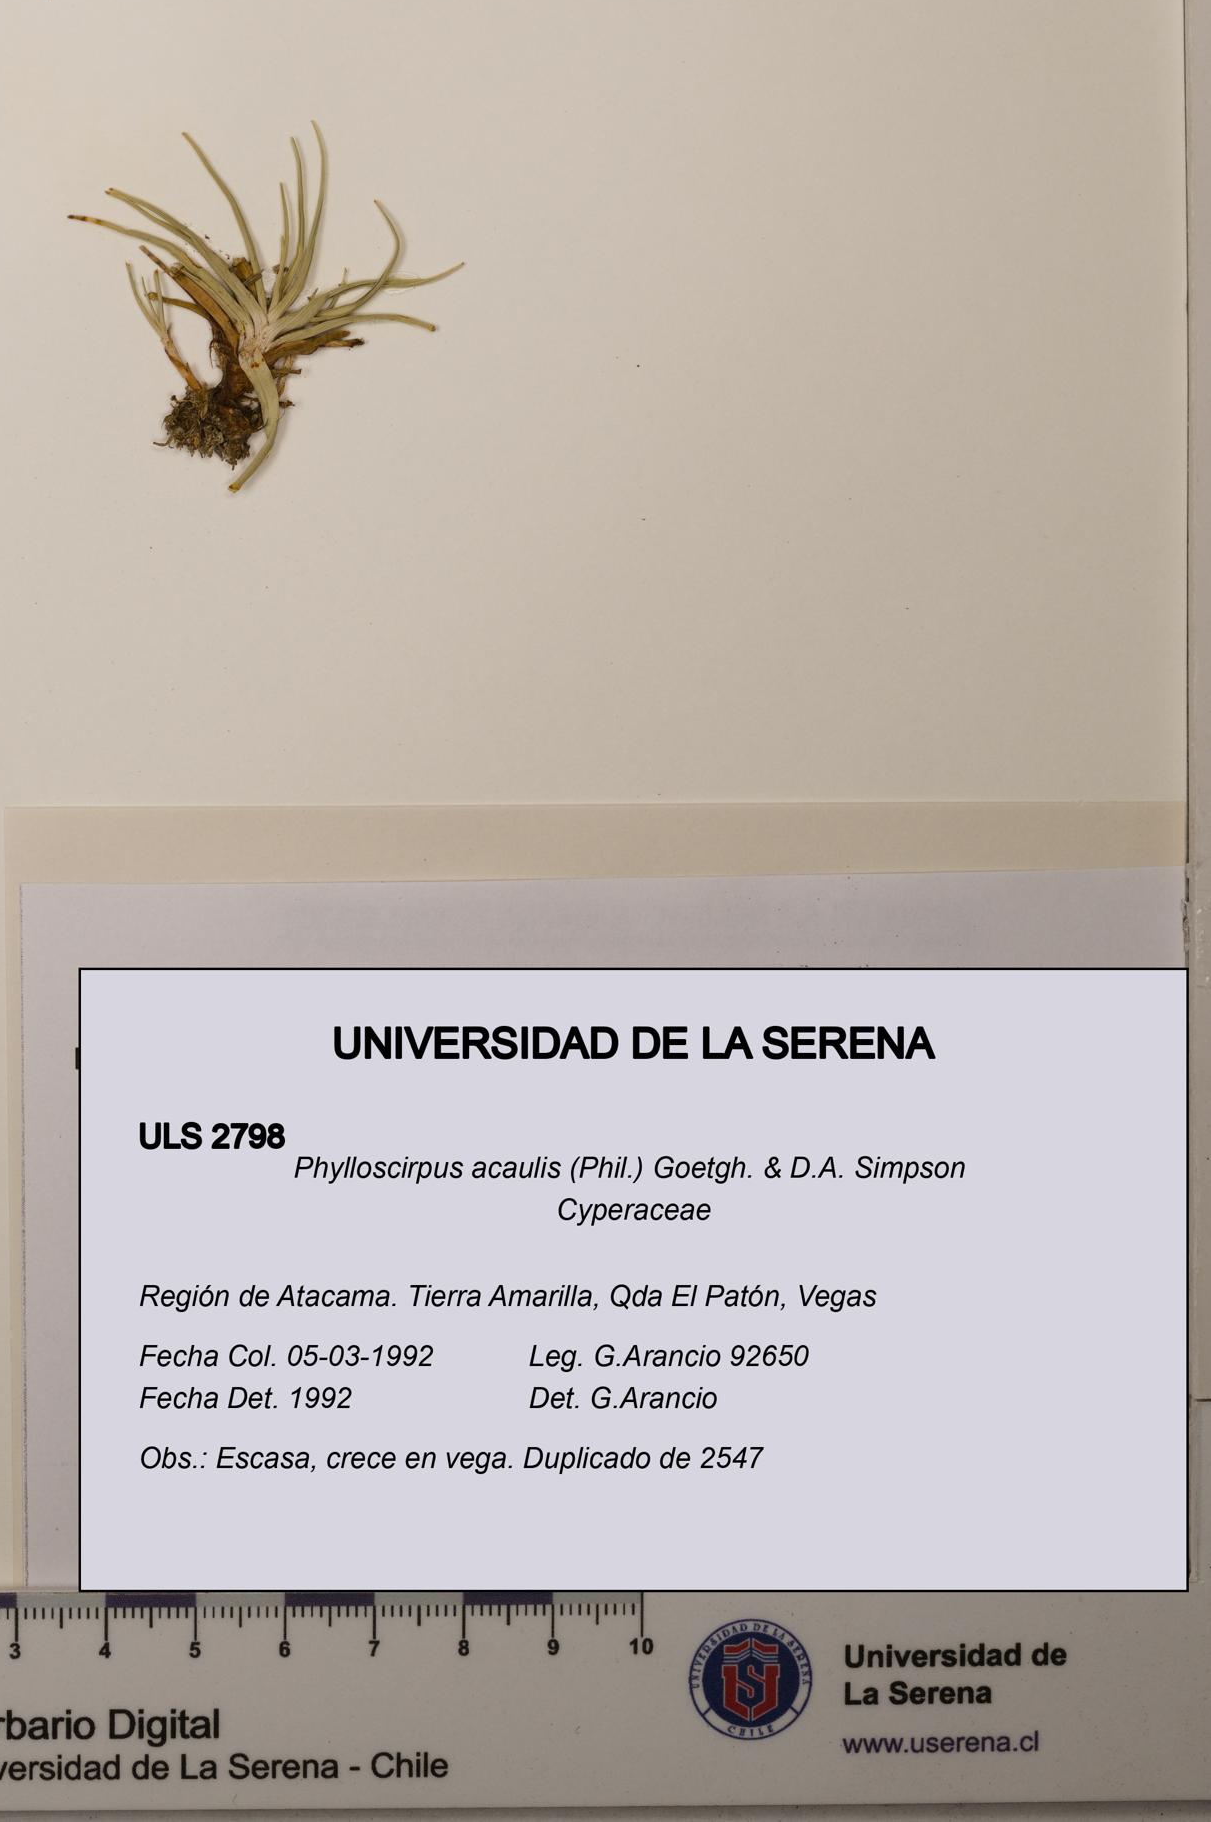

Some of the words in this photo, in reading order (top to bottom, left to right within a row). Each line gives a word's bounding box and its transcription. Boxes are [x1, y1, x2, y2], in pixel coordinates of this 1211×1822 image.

[9, 1643, 22, 1660] 3
[98, 1642, 112, 1659] 4
[189, 1642, 201, 1659] 5
[279, 1641, 291, 1658] 6
[368, 1640, 381, 1657] 7
[458, 1640, 470, 1657] 8
[547, 1639, 560, 1656] 9
[629, 1639, 655, 1655] 10
[844, 1642, 1022, 1668] Universidad
[1031, 1642, 1068, 1667] de
[844, 1682, 880, 1706] La
[888, 1680, 993, 1706] Serena
[108, 1708, 220, 1747] Digital
[842, 1730, 1040, 1755] www.userena.cl
[131, 1754, 169, 1781] de
[180, 1754, 218, 1781] La
[228, 1753, 339, 1781] Serena
[370, 1752, 449, 1779] Chile
